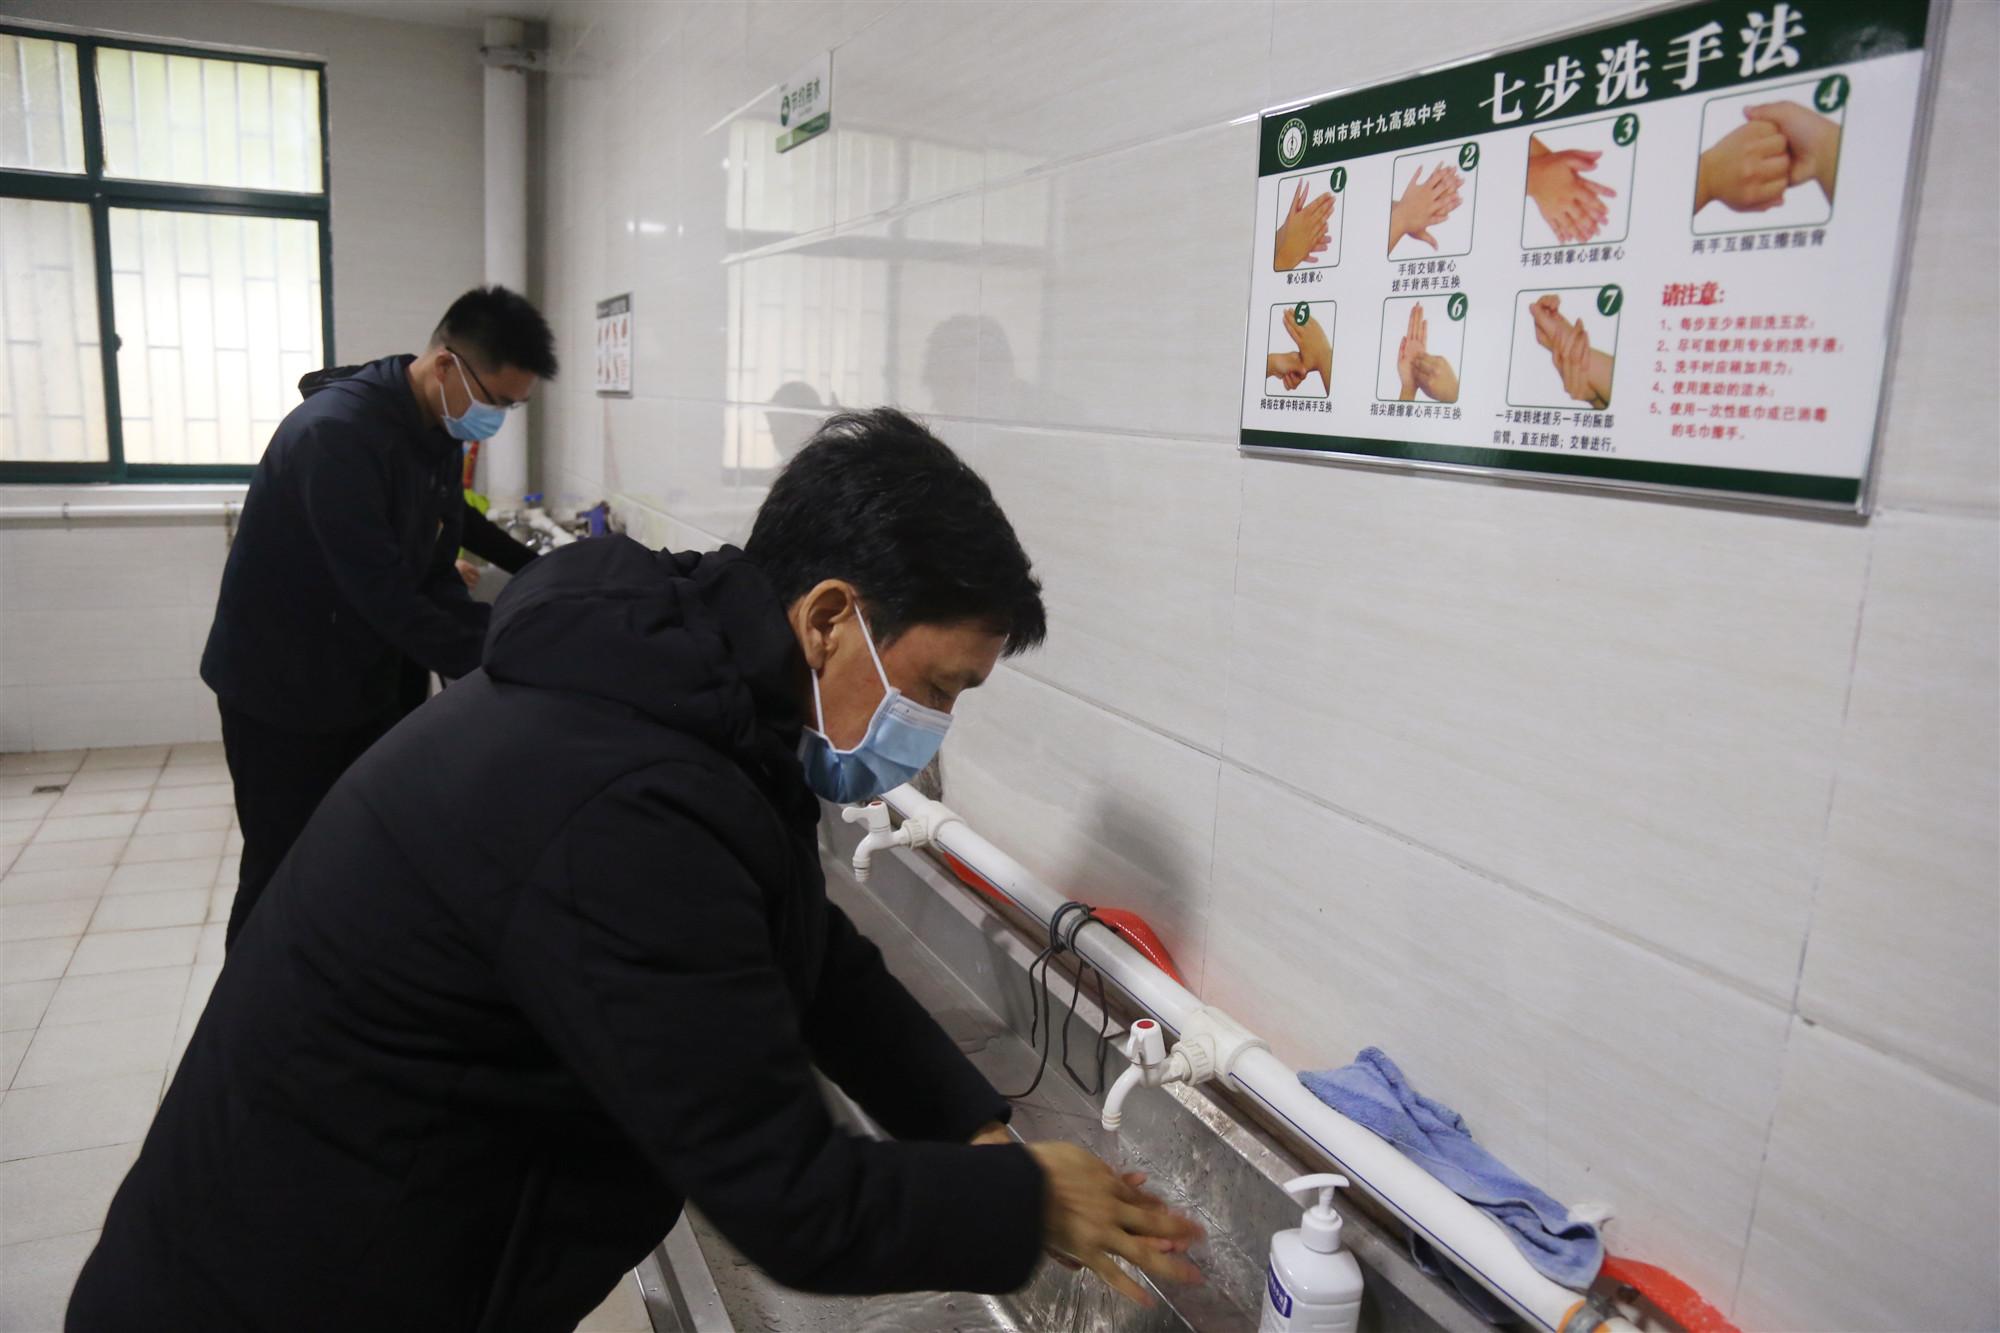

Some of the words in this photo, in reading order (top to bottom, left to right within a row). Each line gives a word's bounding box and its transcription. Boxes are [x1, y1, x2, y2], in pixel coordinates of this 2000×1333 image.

[1478, 3, 1806, 124] 七步洗手法
[1312, 99, 1447, 148] 郑州市第十九高级中学
